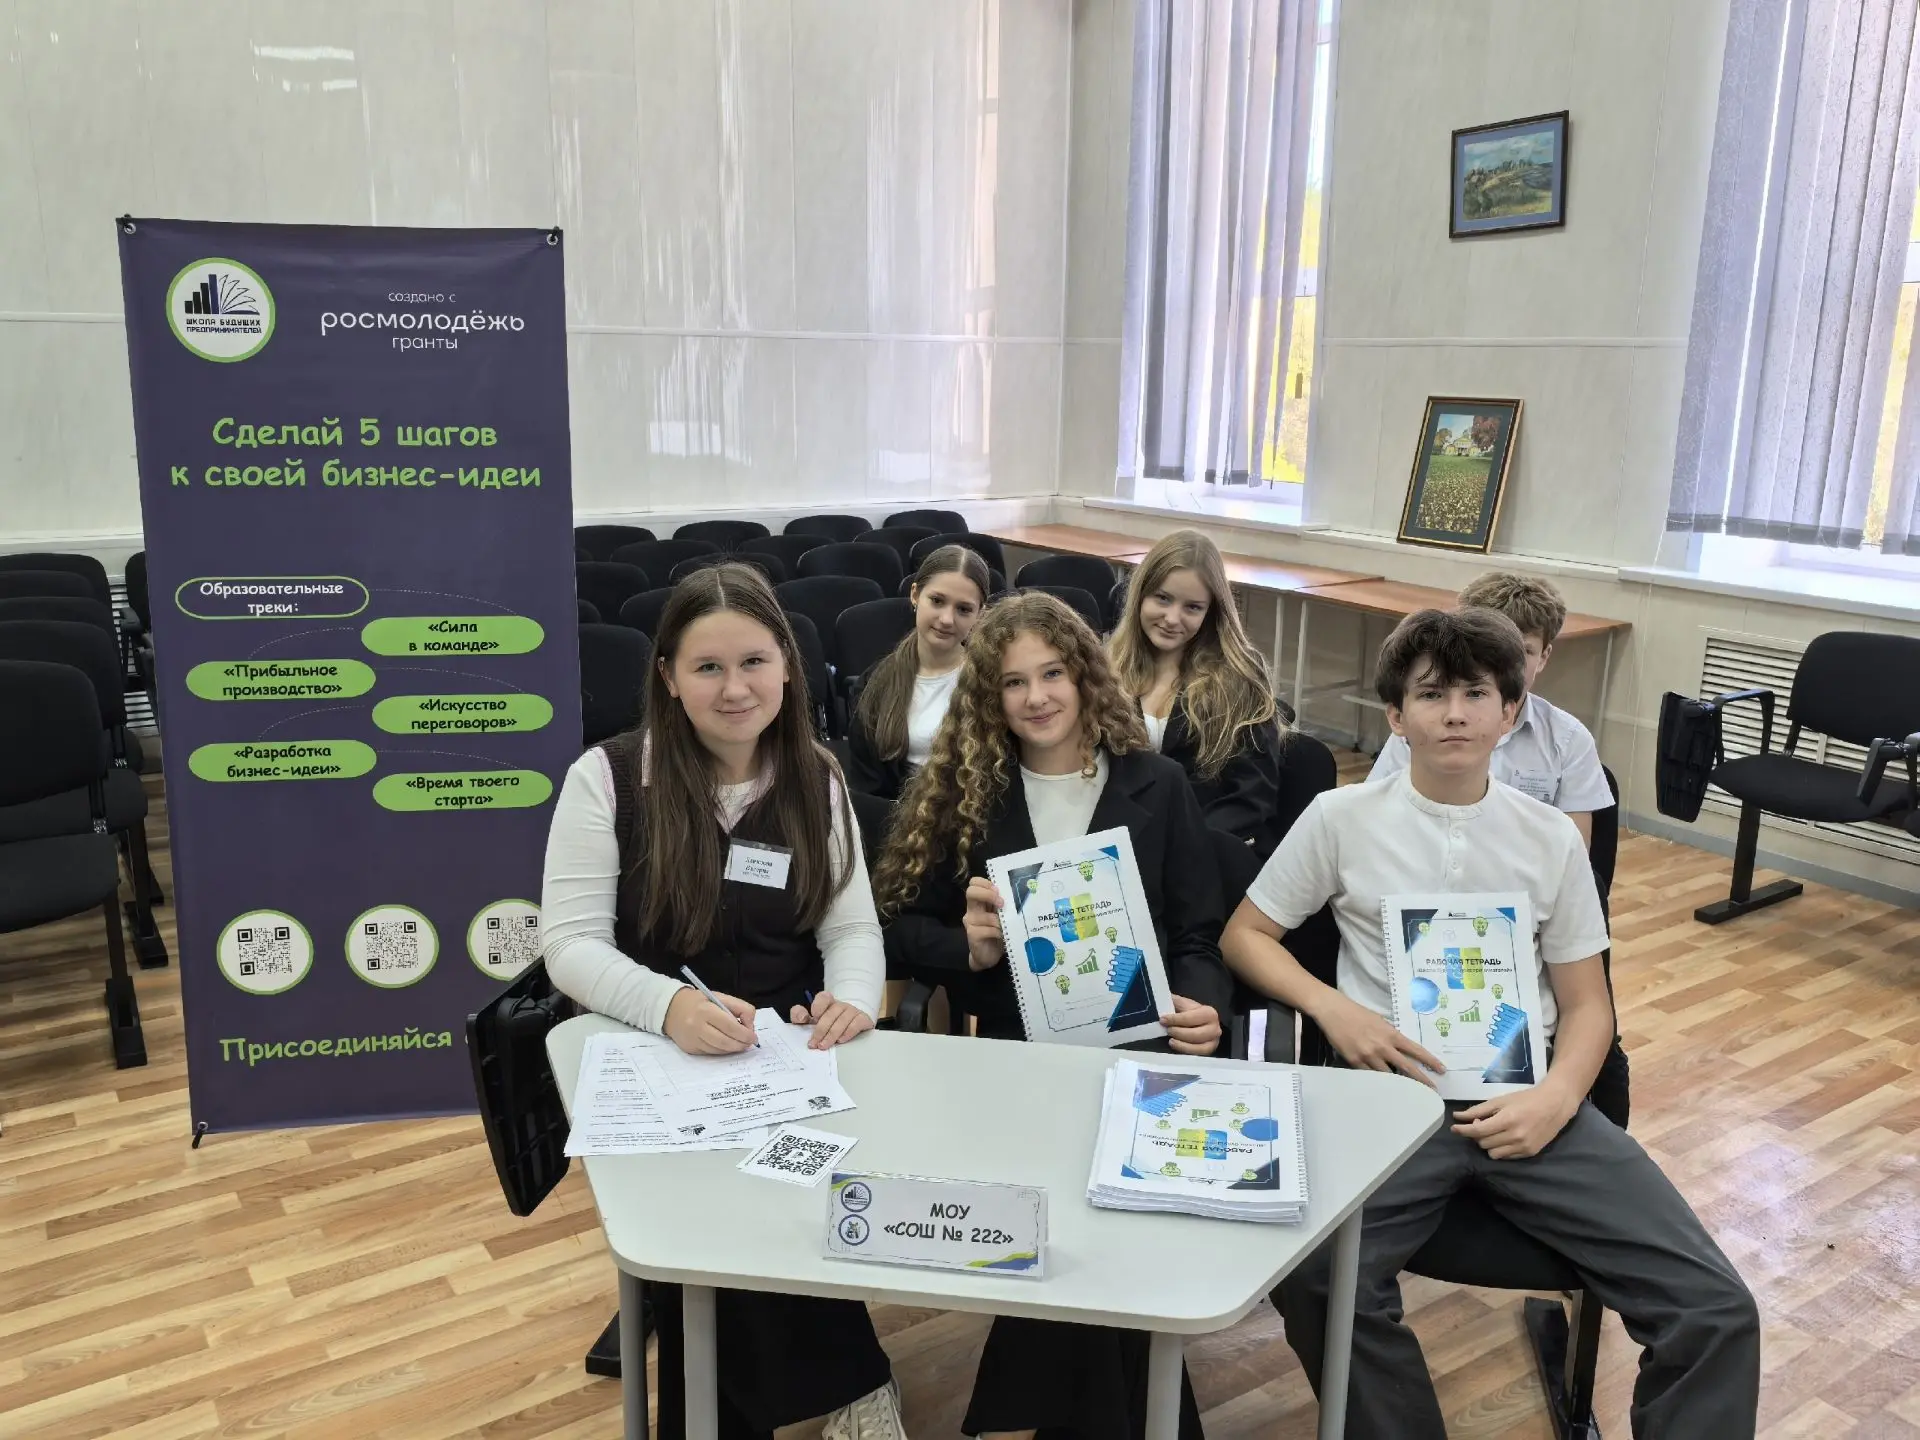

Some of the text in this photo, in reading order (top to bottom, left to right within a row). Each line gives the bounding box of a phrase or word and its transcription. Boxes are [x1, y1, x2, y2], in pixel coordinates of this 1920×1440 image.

[388, 290, 456, 304] создано с
[186, 318, 261, 326] ШКОЛА БУДУЩИХ
[186, 326, 262, 334] ПРЕДПРИНИМАТЕЛЕЙ
[320, 307, 525, 336] росмолодёжь
[391, 335, 458, 352] гранты
[212, 416, 497, 449] Сделай 5 шагов
[171, 458, 541, 489] к своей бизнес-идеи
[200, 580, 344, 598] Образовательные
[247, 600, 300, 617] треки:
[427, 619, 478, 634] «Сила
[408, 638, 500, 653] в команде»
[223, 663, 338, 680] «Прибыльное
[222, 682, 342, 699] производство»
[418, 698, 507, 714] «Искусство
[410, 716, 518, 733] переговоров»
[233, 745, 332, 761] «Разработка
[226, 762, 341, 778] бизнес-идеи»
[405, 774, 520, 791] «Время твоего
[434, 793, 494, 809] старта»
[1037, 908, 1075, 922] РАБОЧАЯ
[1075, 900, 1112, 914] ТЕТРАДЬ
[1425, 958, 1502, 966] РАБОЧАЯ ТЕТРАДЬ
[219, 1027, 453, 1067] Присоединяйся
[929, 1202, 971, 1220] МОУ
[883, 1221, 1014, 1245] «СОШ № 222»
